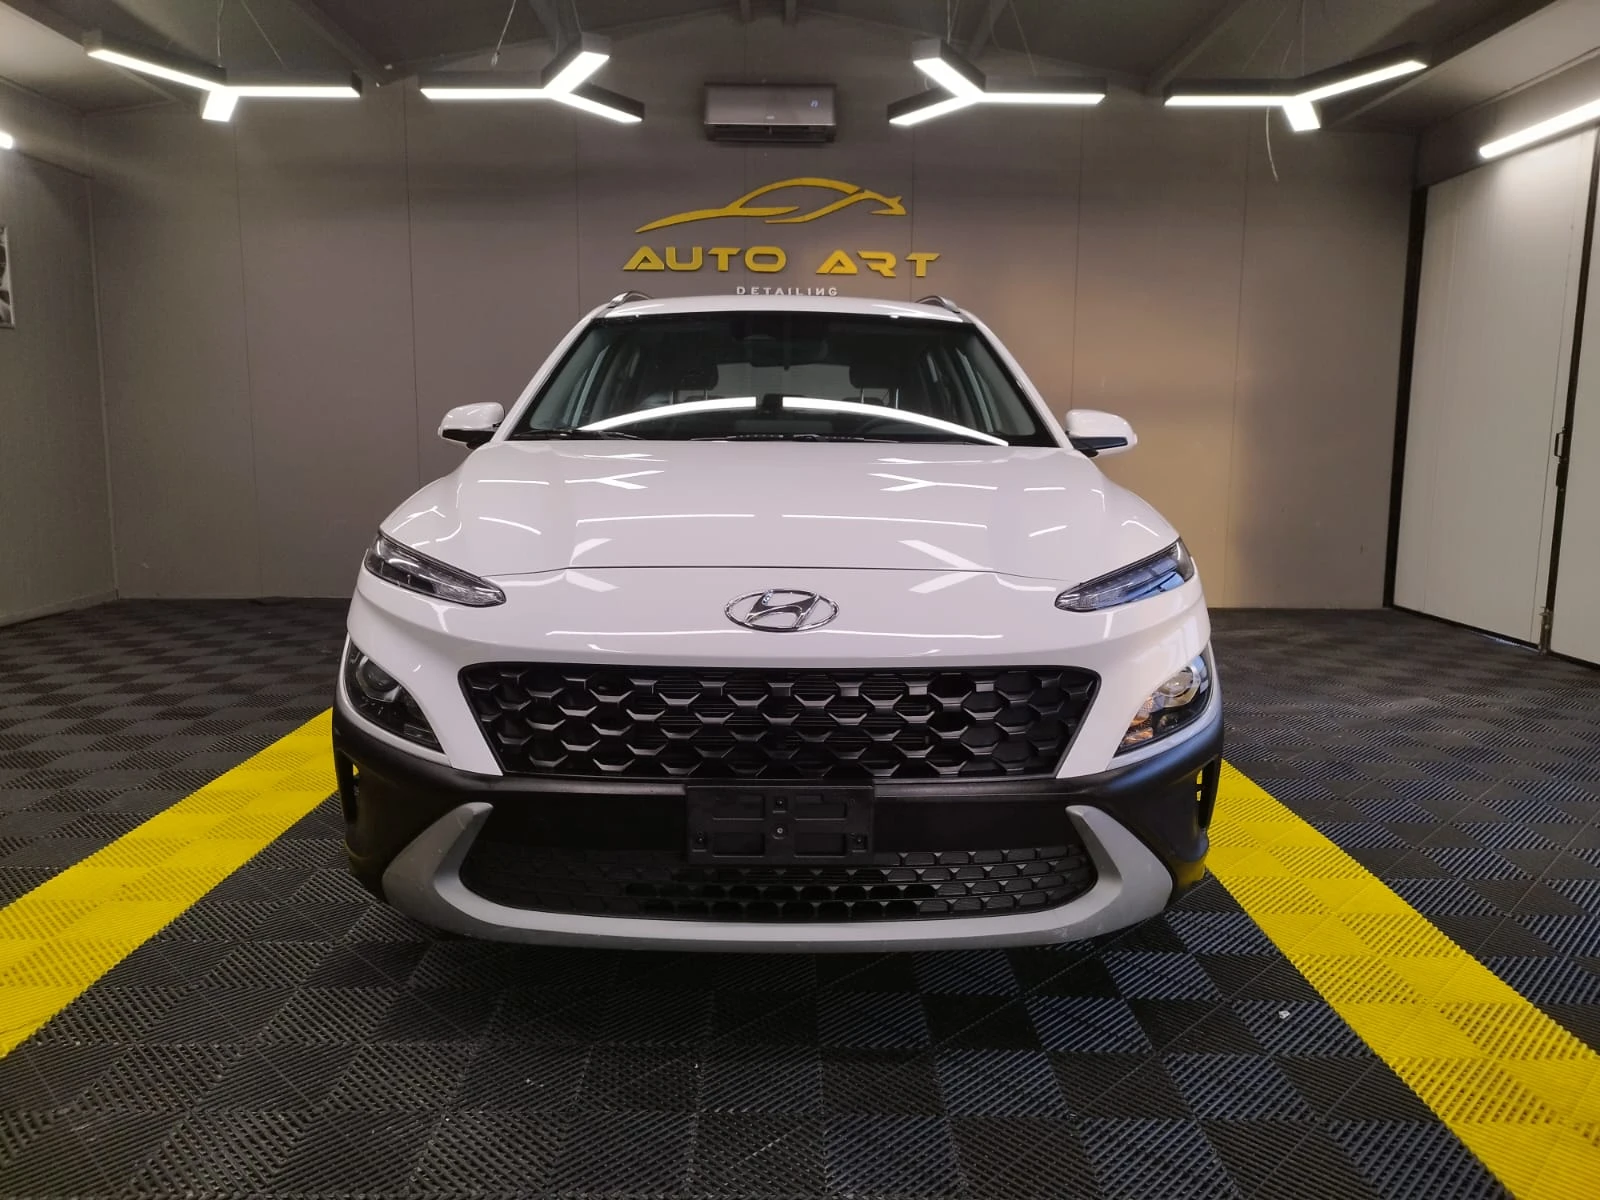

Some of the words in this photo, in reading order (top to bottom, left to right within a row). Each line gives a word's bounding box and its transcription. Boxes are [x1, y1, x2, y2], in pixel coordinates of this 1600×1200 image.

[623, 246, 787, 273] AUTO
[816, 249, 941, 277] ART
[736, 286, 839, 297] DETAILING
